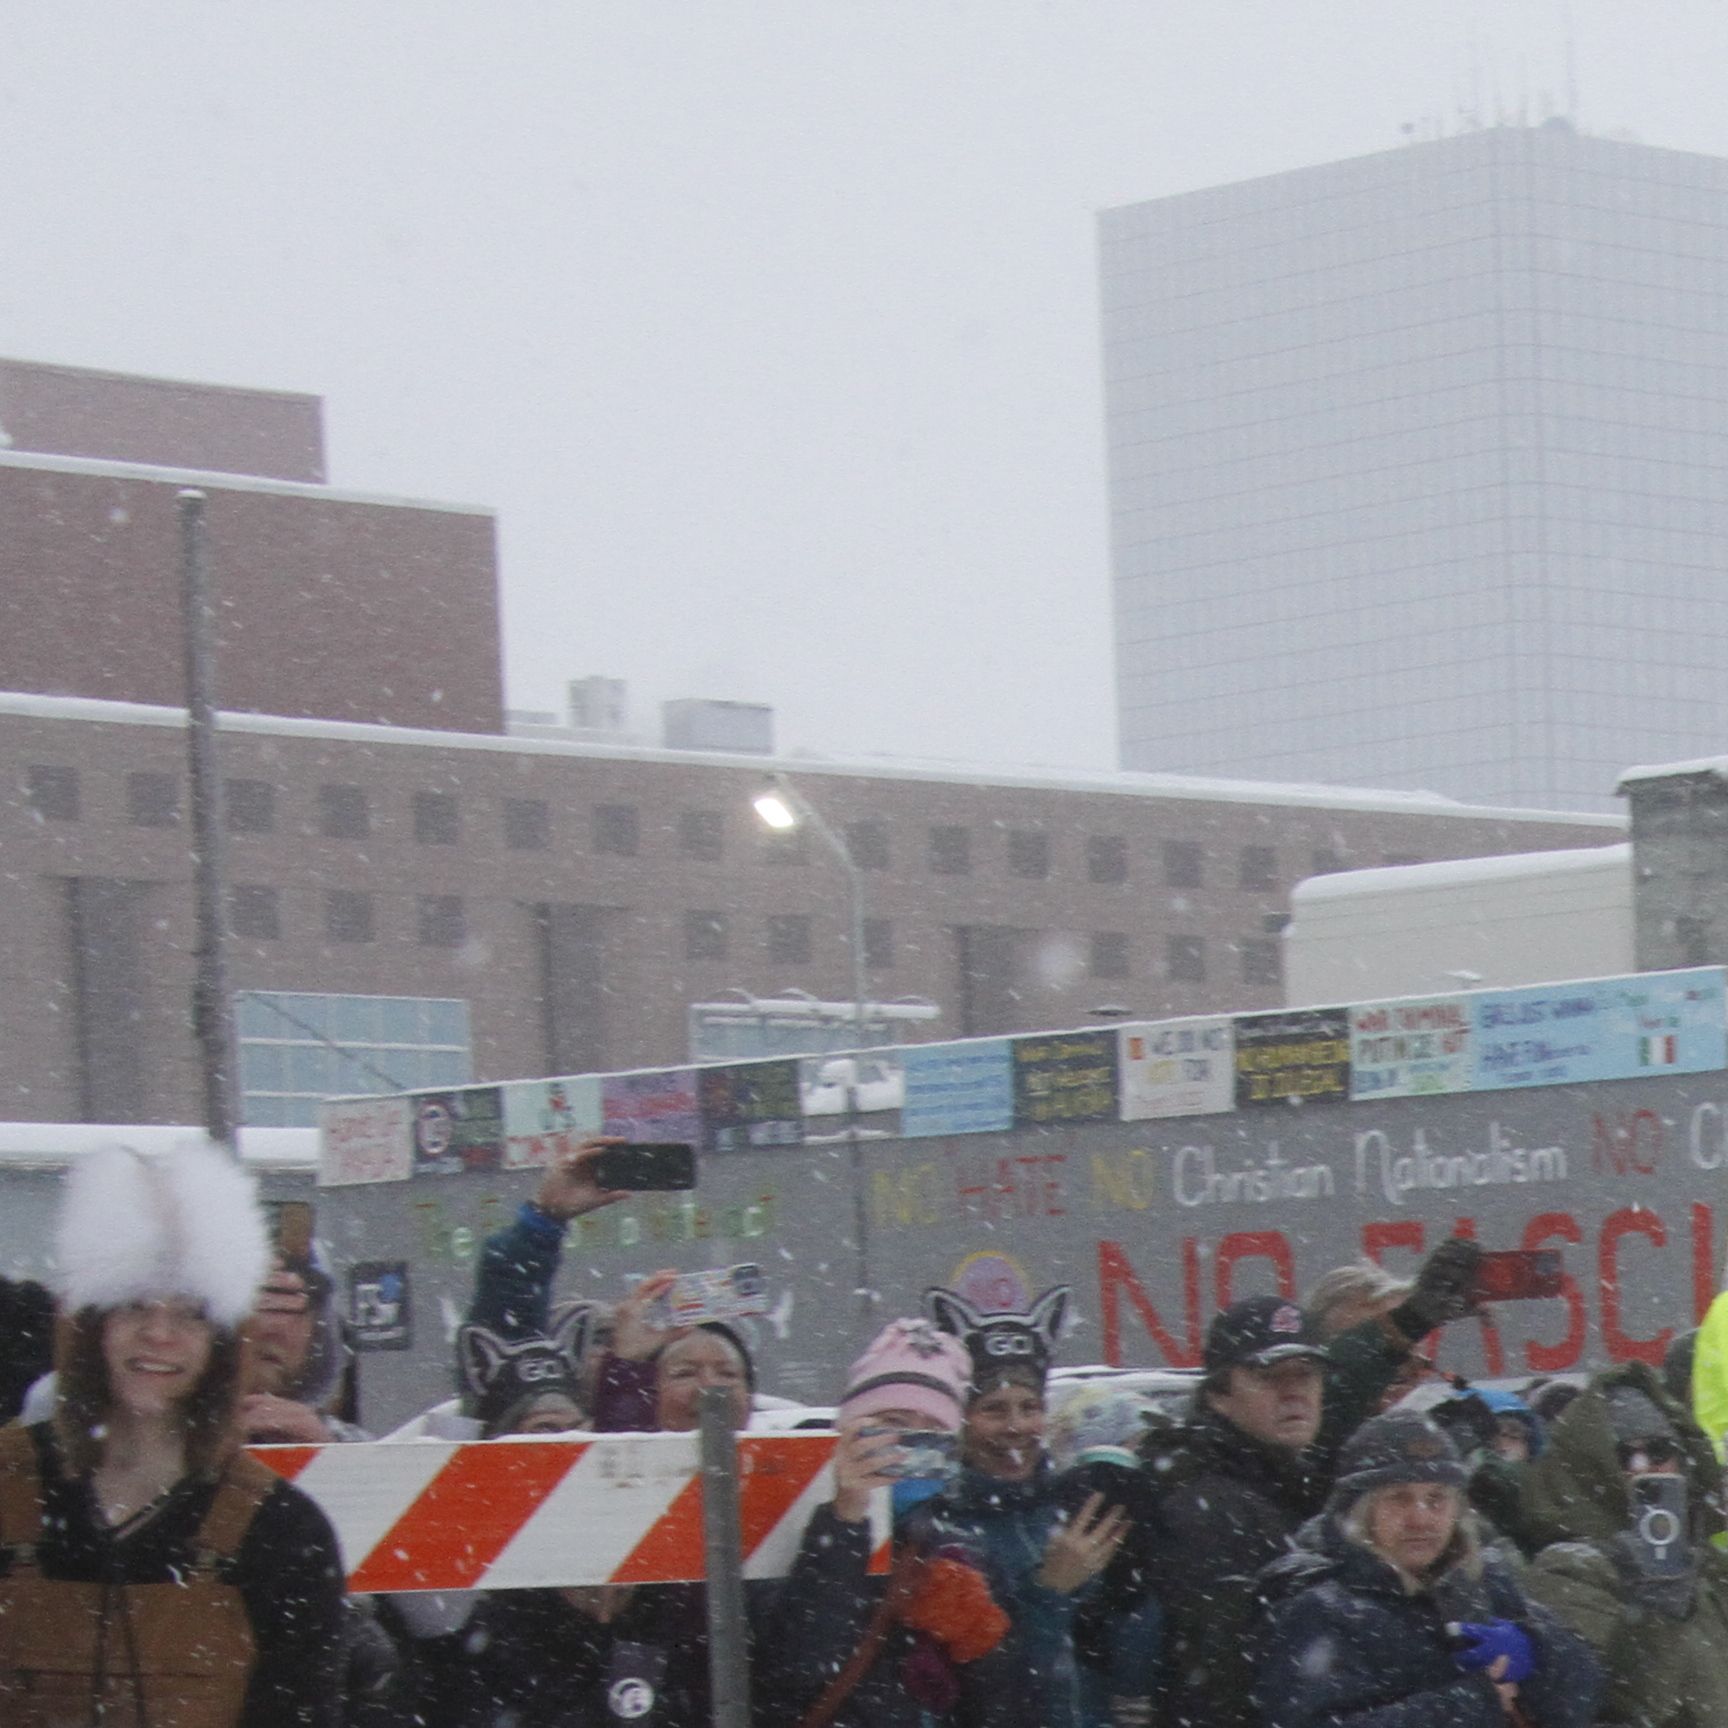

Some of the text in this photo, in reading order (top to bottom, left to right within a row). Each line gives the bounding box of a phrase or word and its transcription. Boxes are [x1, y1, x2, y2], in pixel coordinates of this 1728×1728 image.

[1172, 1143, 1337, 1207] Christian
[1354, 1120, 1569, 1203] Nationalism
[1592, 1107, 1662, 1177] NO
